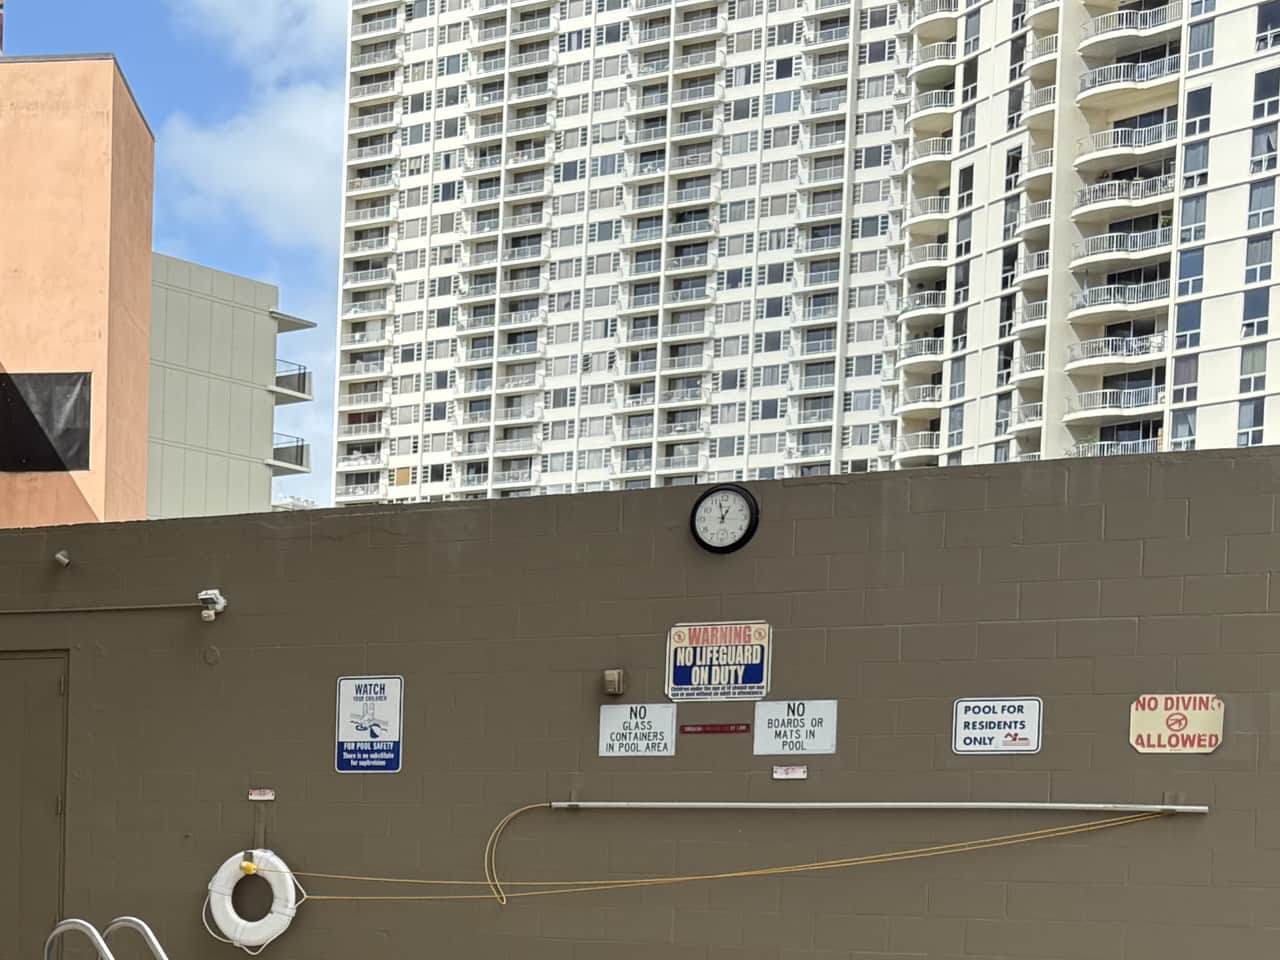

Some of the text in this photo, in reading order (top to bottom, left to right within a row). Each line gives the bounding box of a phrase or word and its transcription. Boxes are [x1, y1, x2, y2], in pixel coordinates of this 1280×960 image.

[688, 626, 751, 645] WARNING
[676, 645, 761, 666] NO LIFEGUARD
[691, 665, 745, 685] ON DUTY
[355, 683, 385, 695] WATCH
[786, 702, 805, 717] NO
[964, 704, 1024, 715] POOL FOR
[1135, 697, 1159, 711] NO
[629, 705, 647, 720] NO
[622, 721, 653, 731] GLASS
[767, 717, 824, 729] BOARDS OR
[963, 720, 1026, 730] RESIDENTS
[609, 731, 665, 742] CONTAINERS
[774, 729, 816, 739] MATS IN
[344, 741, 394, 750] FOR POOL SAFETY
[782, 740, 806, 751] POOL
[963, 736, 995, 746] ONLY
[1135, 733, 1219, 748] ALLOWED
[606, 742, 669, 752] IN POOL AREA
